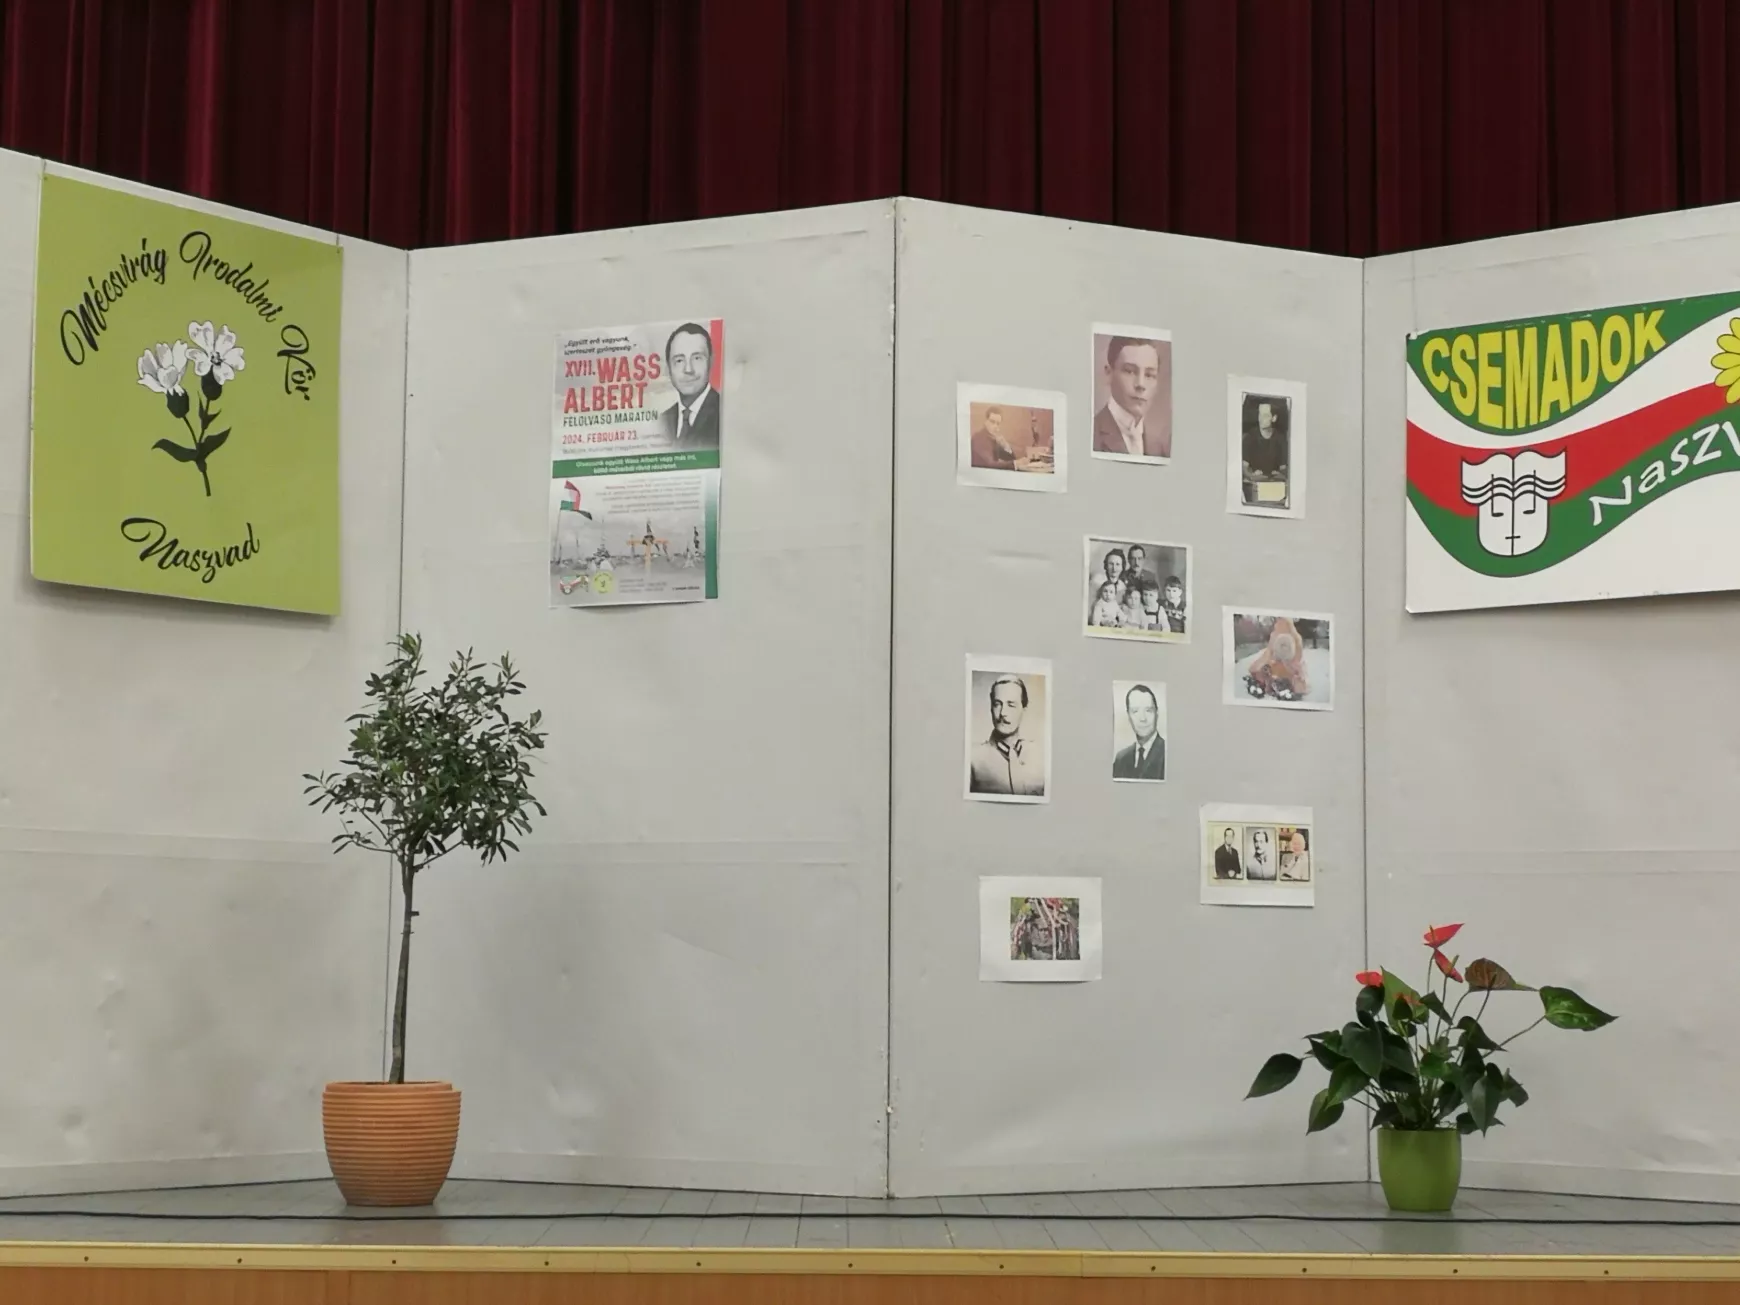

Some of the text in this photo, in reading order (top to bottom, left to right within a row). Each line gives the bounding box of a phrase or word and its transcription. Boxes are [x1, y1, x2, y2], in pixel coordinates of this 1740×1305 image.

[60, 238, 166, 366] Mécsvirág
[277, 324, 317, 401] Kör
[565, 353, 661, 383] XVII. WASS
[1422, 308, 1666, 430] CSEMADOK
[564, 382, 647, 414] ALBERT
[614, 410, 658, 424] MARATON
[562, 434, 584, 445] 2024.
[120, 517, 261, 583] Naszvad
